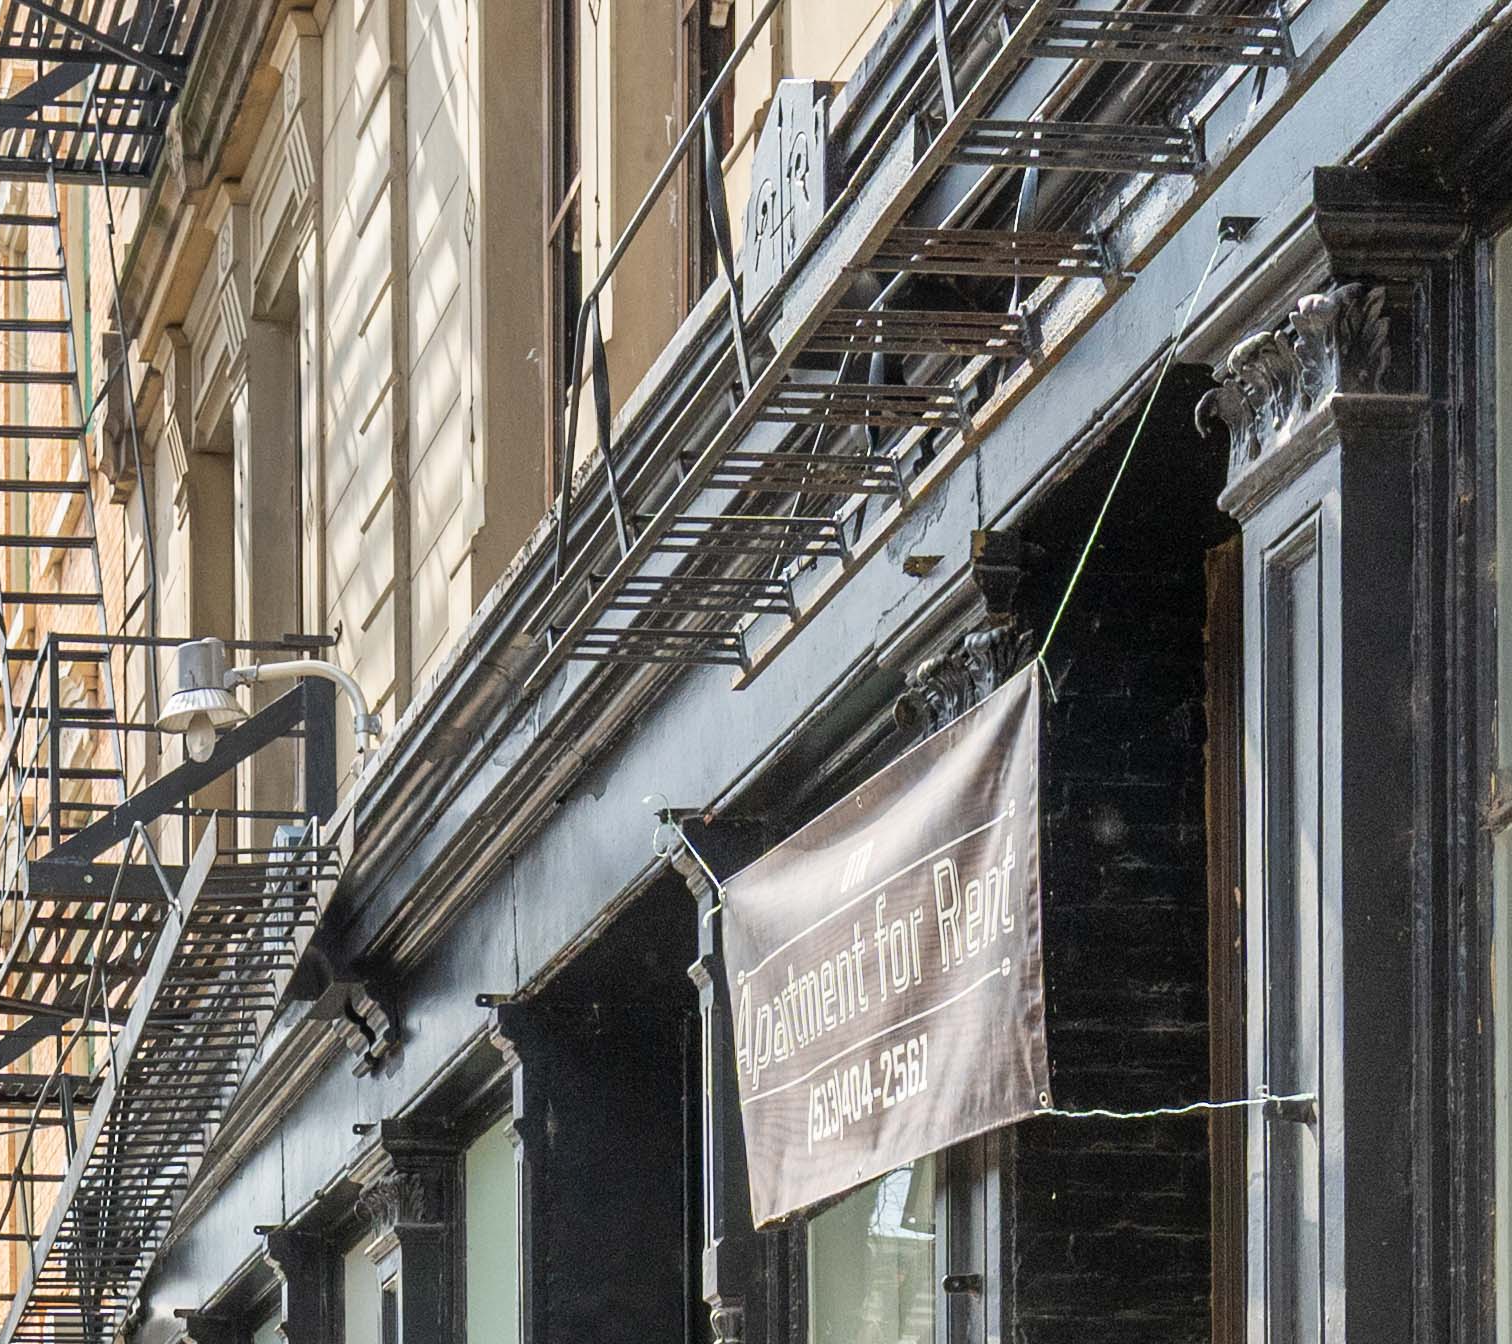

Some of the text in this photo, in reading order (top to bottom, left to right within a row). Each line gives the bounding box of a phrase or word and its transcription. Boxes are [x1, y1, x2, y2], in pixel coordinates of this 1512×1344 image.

[737, 833, 1016, 1091] Apartment for Rent
[808, 1033, 928, 1153] (513)404-2561
